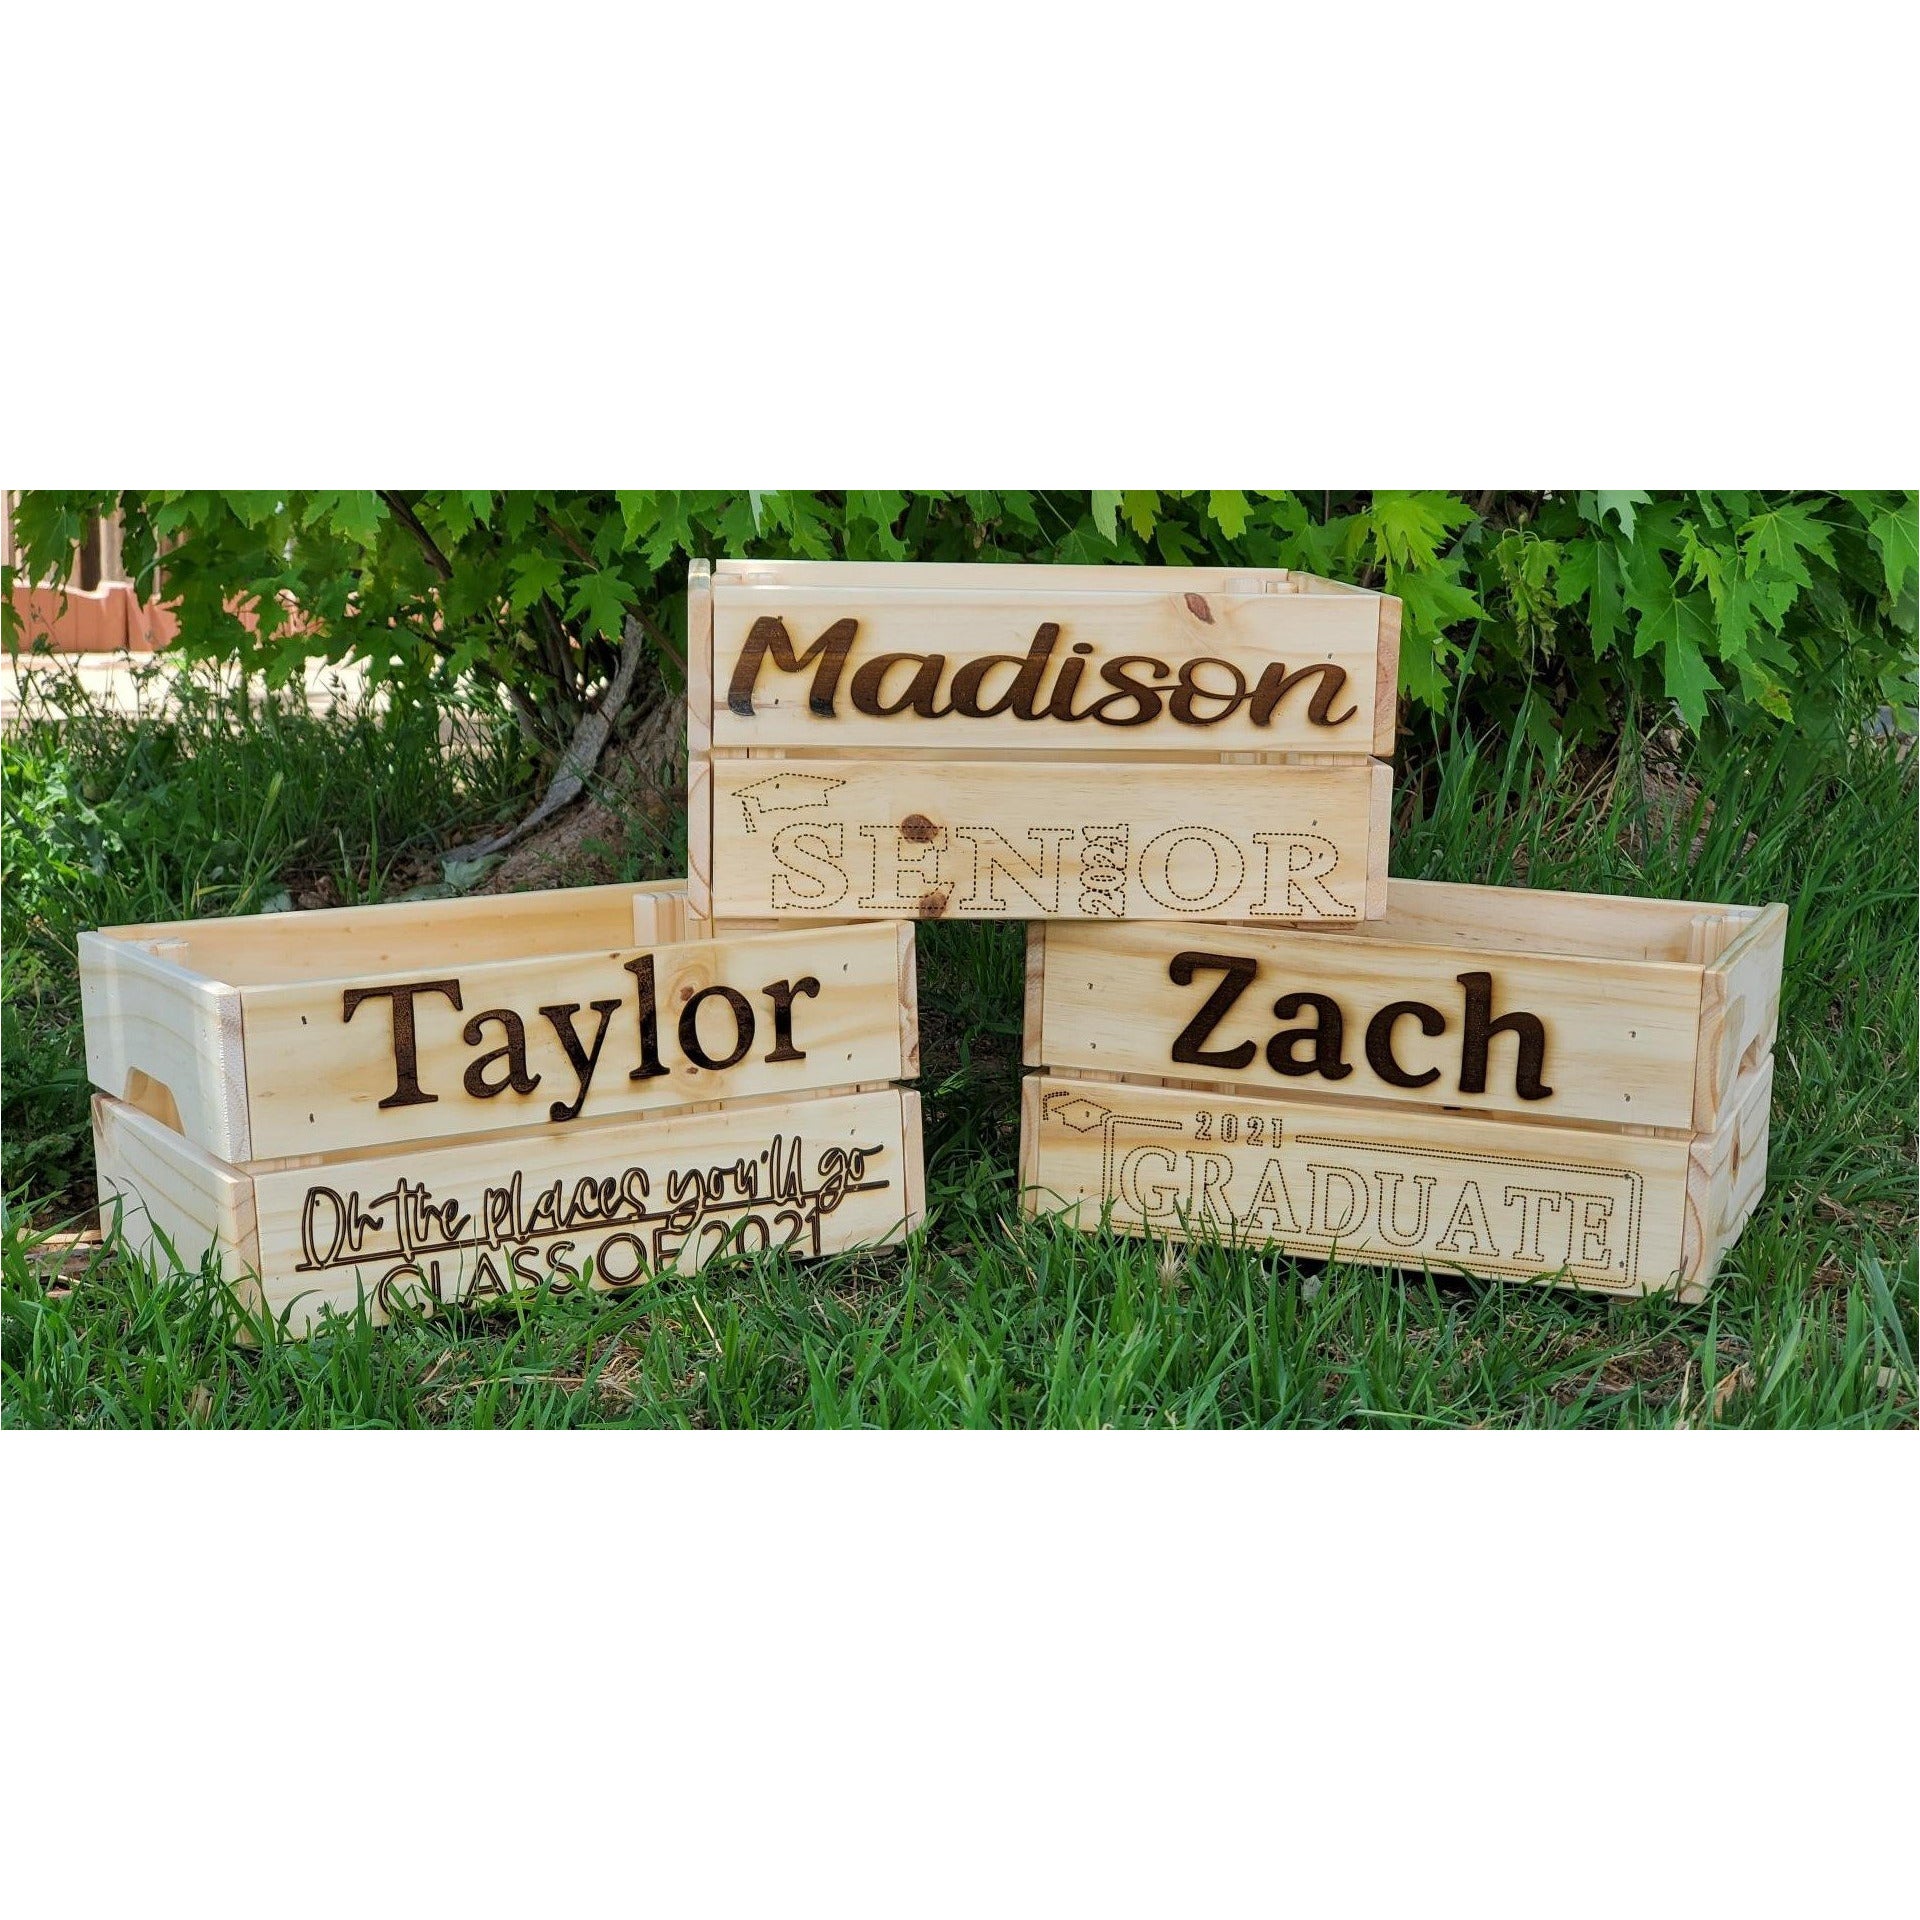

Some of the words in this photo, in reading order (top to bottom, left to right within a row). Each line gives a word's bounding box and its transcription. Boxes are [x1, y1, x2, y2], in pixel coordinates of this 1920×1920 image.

[727, 614, 1358, 727] Madison
[342, 953, 821, 1122] Taylor
[1169, 950, 1554, 1101] Zach
[1194, 1110, 1283, 1149] 2021
[301, 1185, 384, 1270] Oh
[368, 1176, 472, 1263] the
[483, 1169, 651, 1251] places
[666, 1133, 804, 1231] you'll
[817, 1143, 884, 1215] go
[377, 1240, 580, 1320] CLASS
[596, 1226, 685, 1286] OF
[700, 1204, 821, 1270] 2021
[1119, 1144, 1615, 1271] GRADUATE
